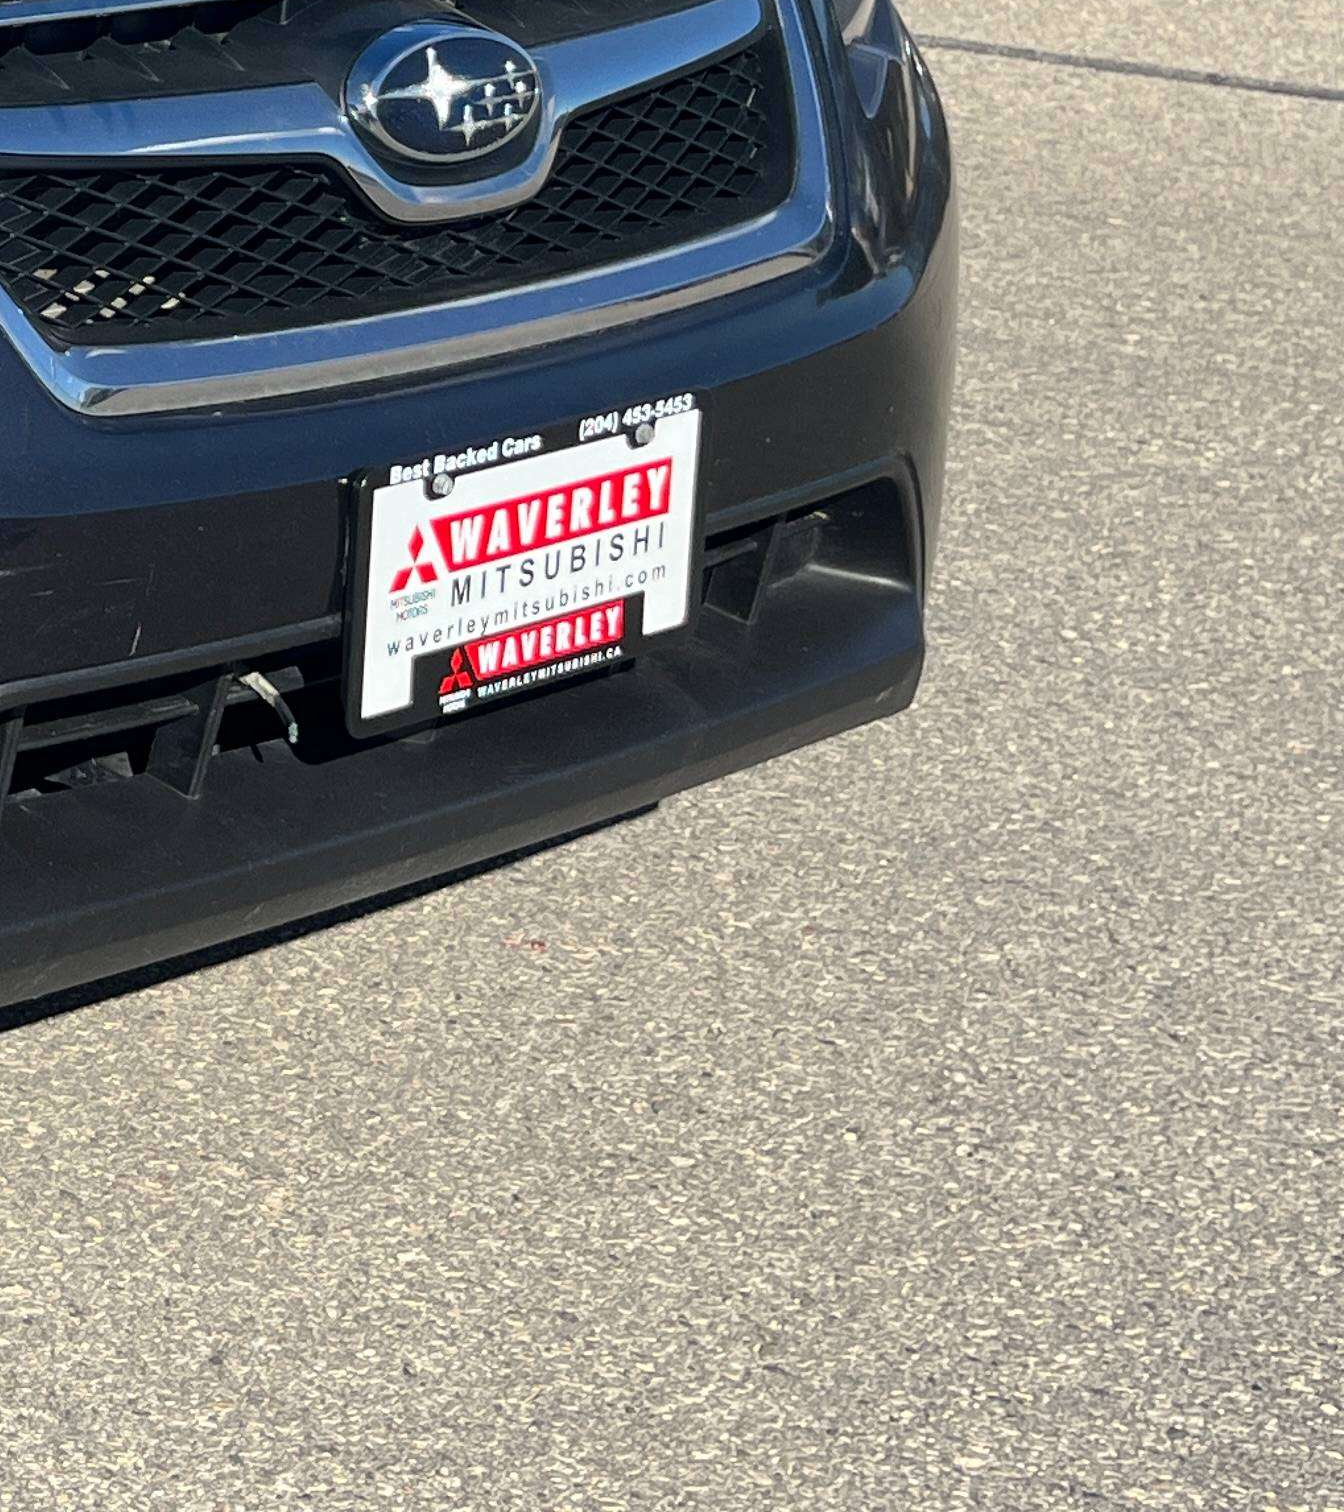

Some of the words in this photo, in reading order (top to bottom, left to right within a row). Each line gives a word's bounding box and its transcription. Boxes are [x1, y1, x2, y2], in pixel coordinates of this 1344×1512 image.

[578, 413, 618, 441] (204)
[622, 393, 693, 426] 453-5453
[389, 462, 431, 485] Best
[434, 443, 499, 475] Backed
[501, 434, 543, 458] Cars
[449, 465, 670, 564] WAVERLEY
[450, 522, 666, 607] MITSUBISHI
[387, 564, 666, 657] waverleymitsubishi.com
[478, 605, 622, 675] WAVERLEY
[476, 645, 623, 699] WAVERLEYMITSUBISHI.CA
